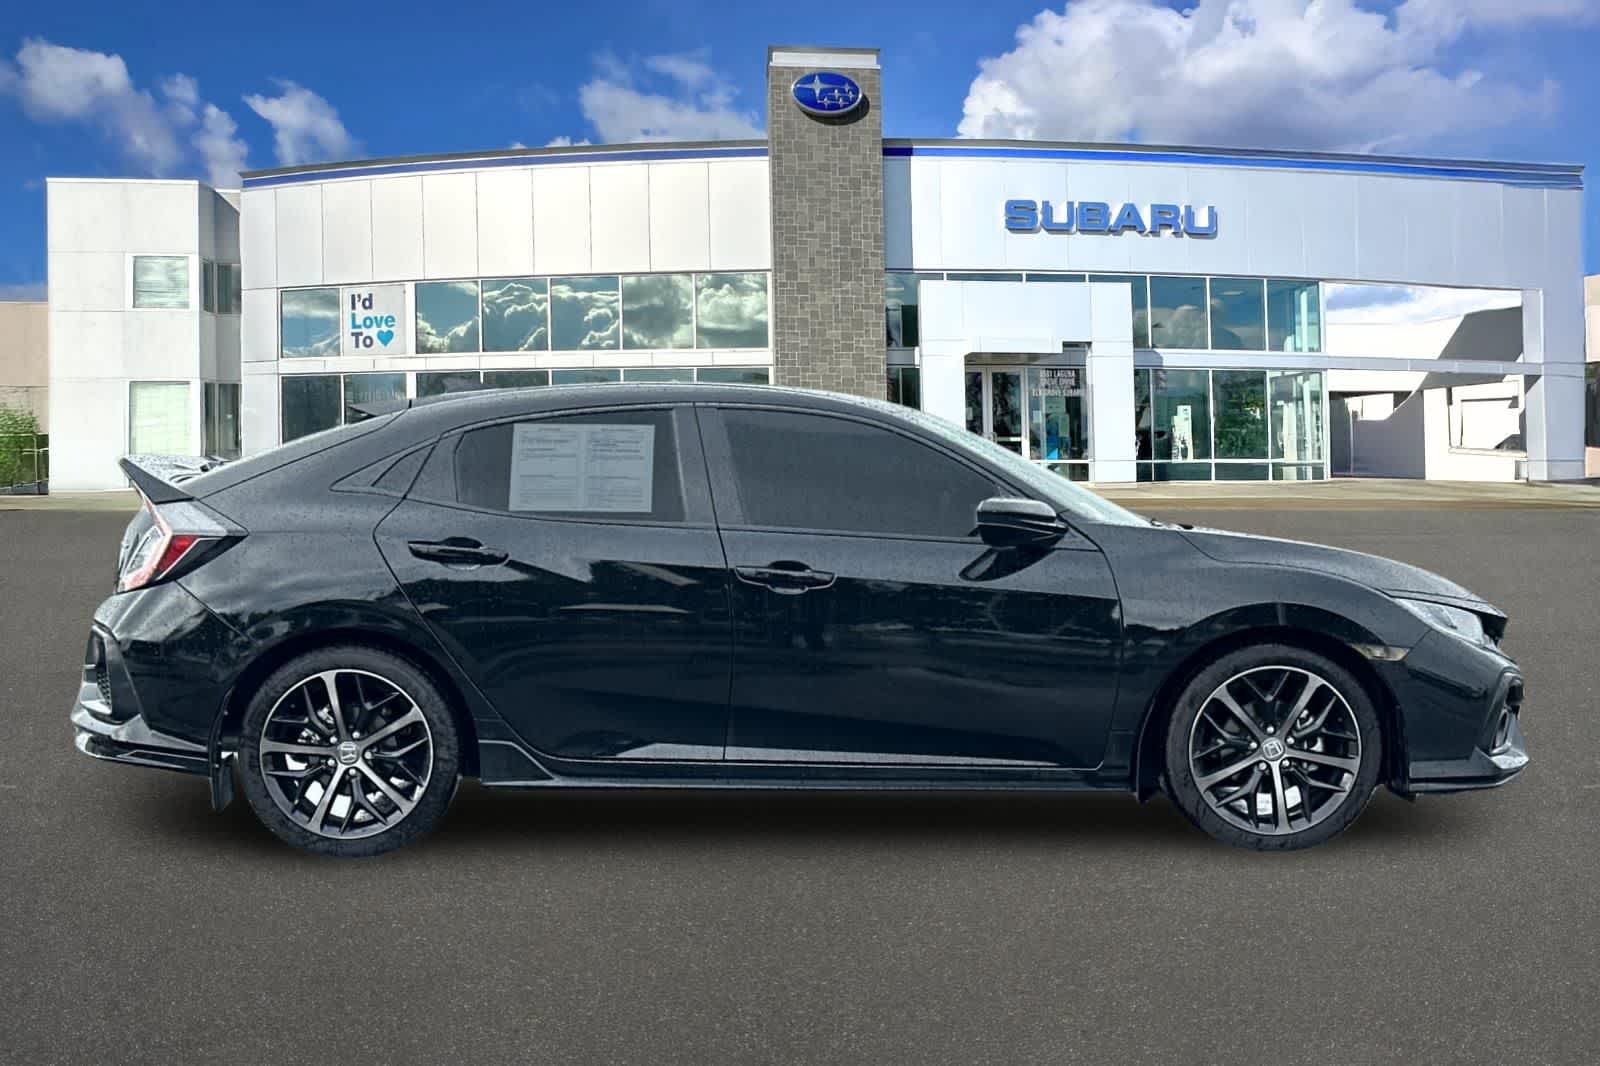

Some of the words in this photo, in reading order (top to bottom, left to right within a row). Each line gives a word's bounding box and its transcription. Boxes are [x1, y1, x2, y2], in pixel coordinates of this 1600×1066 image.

[1005, 199, 1217, 236] SUBARU
[351, 312, 396, 329] Love
[351, 331, 374, 349] To
